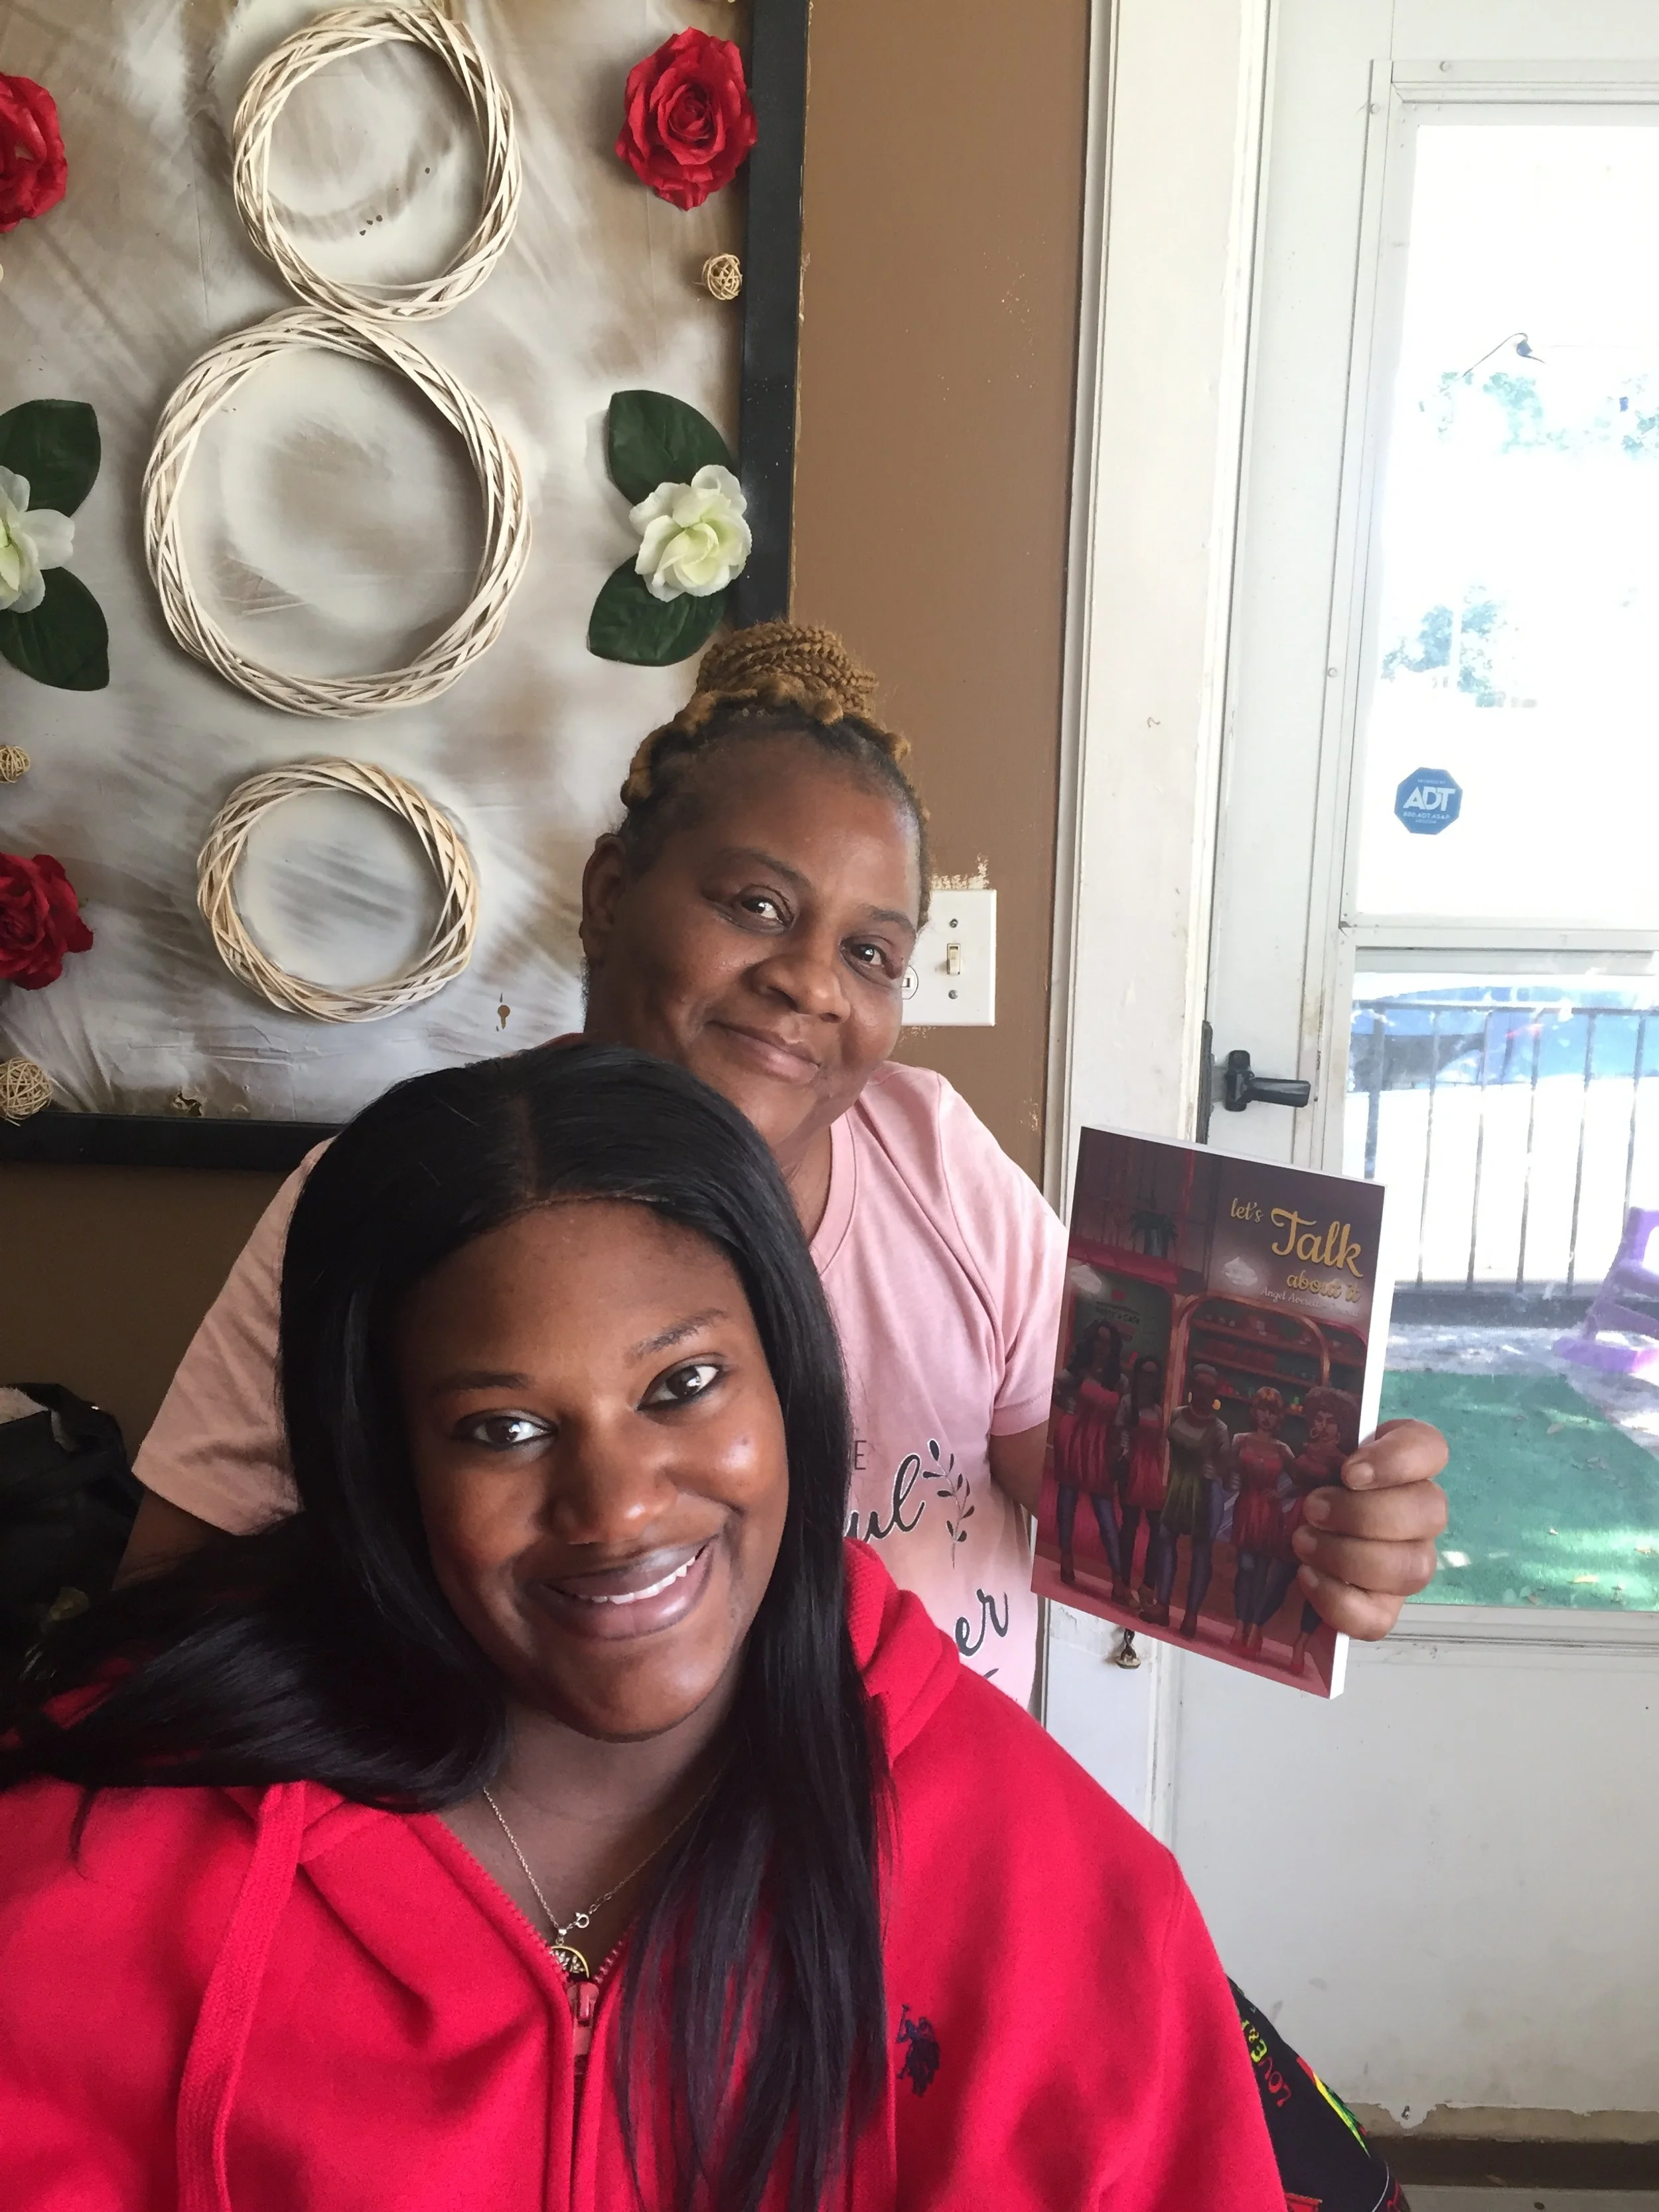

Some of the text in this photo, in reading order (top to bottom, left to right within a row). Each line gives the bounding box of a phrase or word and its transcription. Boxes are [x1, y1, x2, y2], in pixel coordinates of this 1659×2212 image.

[1403, 786, 1455, 811] ADT
[1230, 1197, 1263, 1223] let's
[1271, 1207, 1363, 1278] Talk
[1287, 1270, 1361, 1303] about it
[843, 1452, 925, 1542] ul
[955, 1587, 1009, 1657] er
